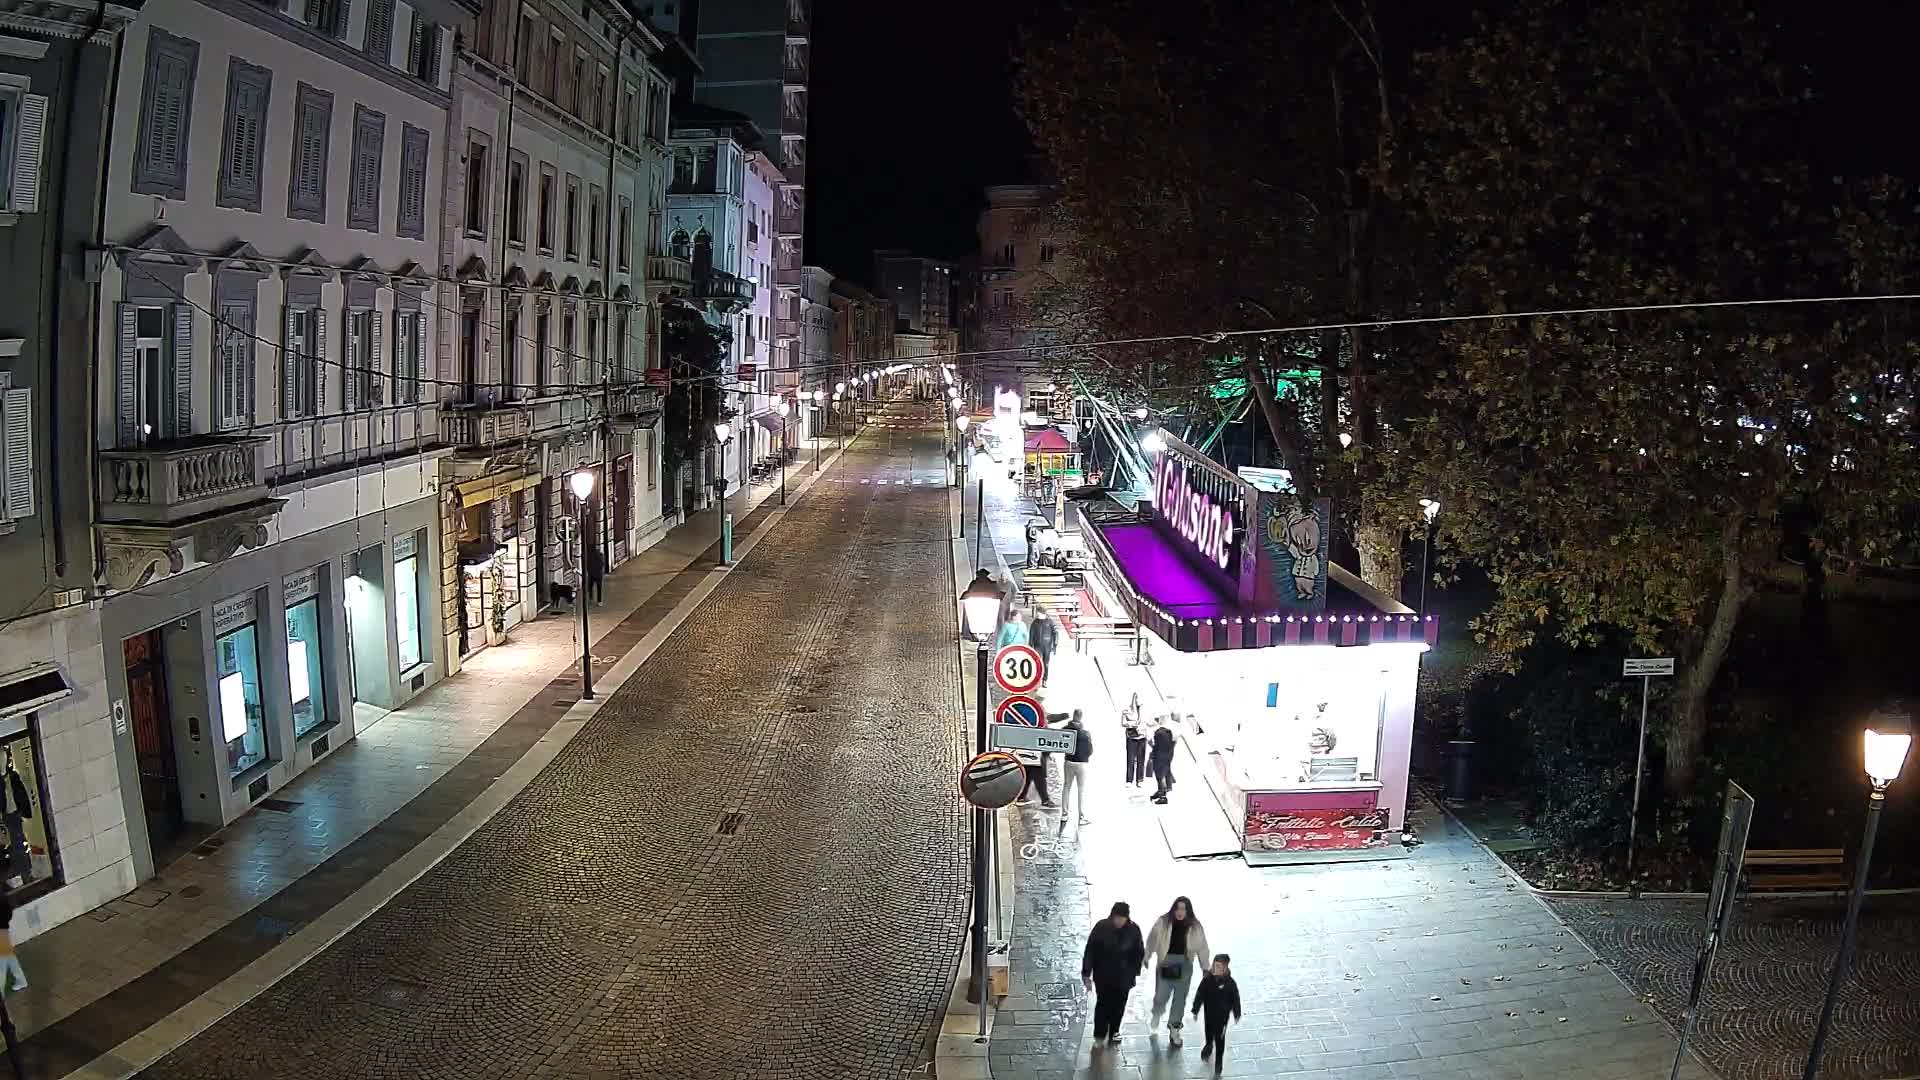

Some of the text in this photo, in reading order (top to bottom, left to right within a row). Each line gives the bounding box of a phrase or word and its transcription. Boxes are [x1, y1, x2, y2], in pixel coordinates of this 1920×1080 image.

[1162, 458, 1233, 569] Golosone
[1005, 657, 1033, 680] 30
[1038, 737, 1069, 749] Dante
